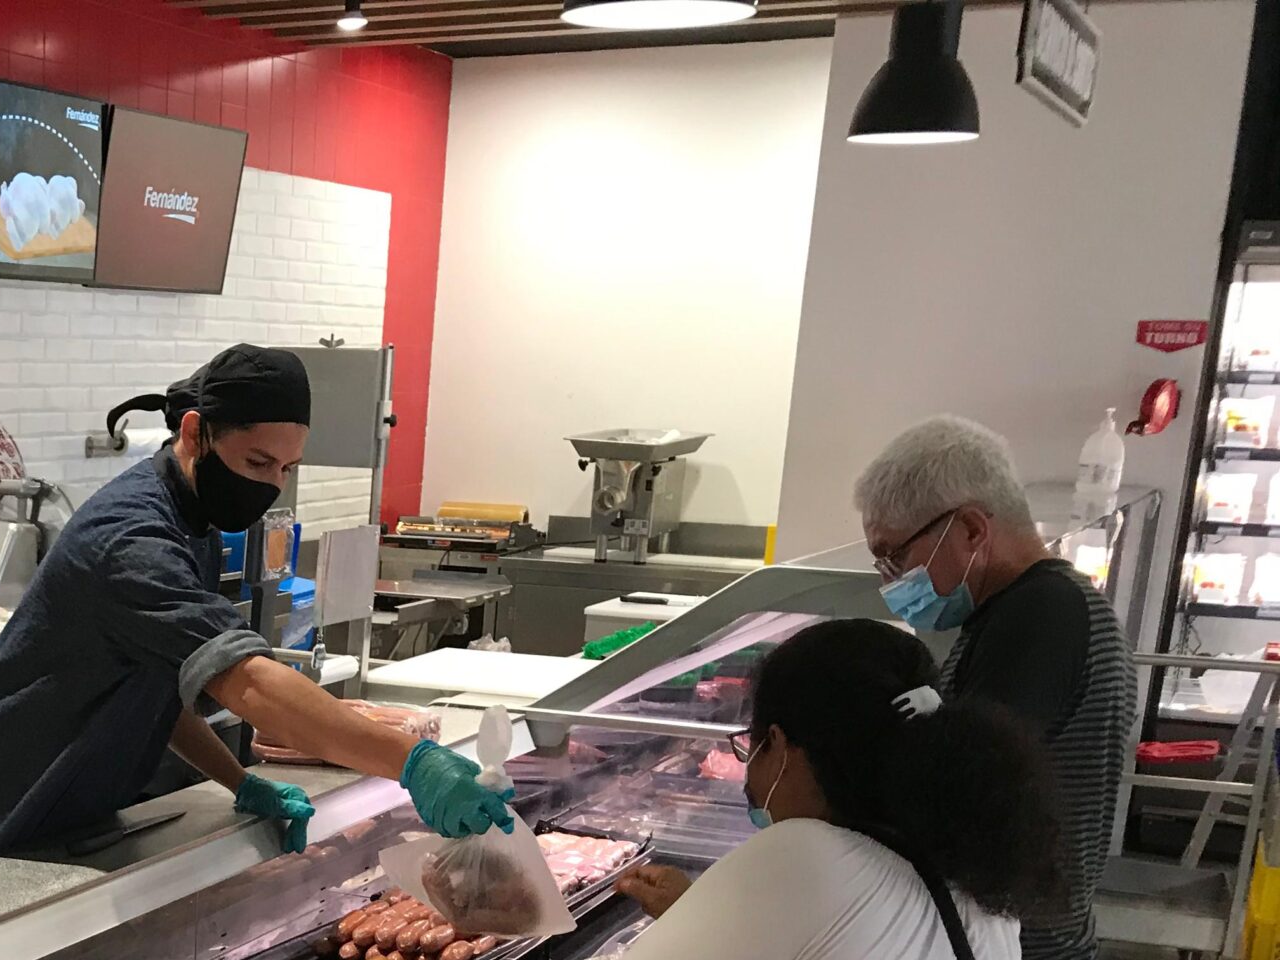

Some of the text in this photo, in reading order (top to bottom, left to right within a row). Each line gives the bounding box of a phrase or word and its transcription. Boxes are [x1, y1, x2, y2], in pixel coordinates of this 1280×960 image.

[66, 106, 100, 124] Fernández
[143, 186, 200, 212] Fernández
[1145, 332, 1199, 344] TURNO
